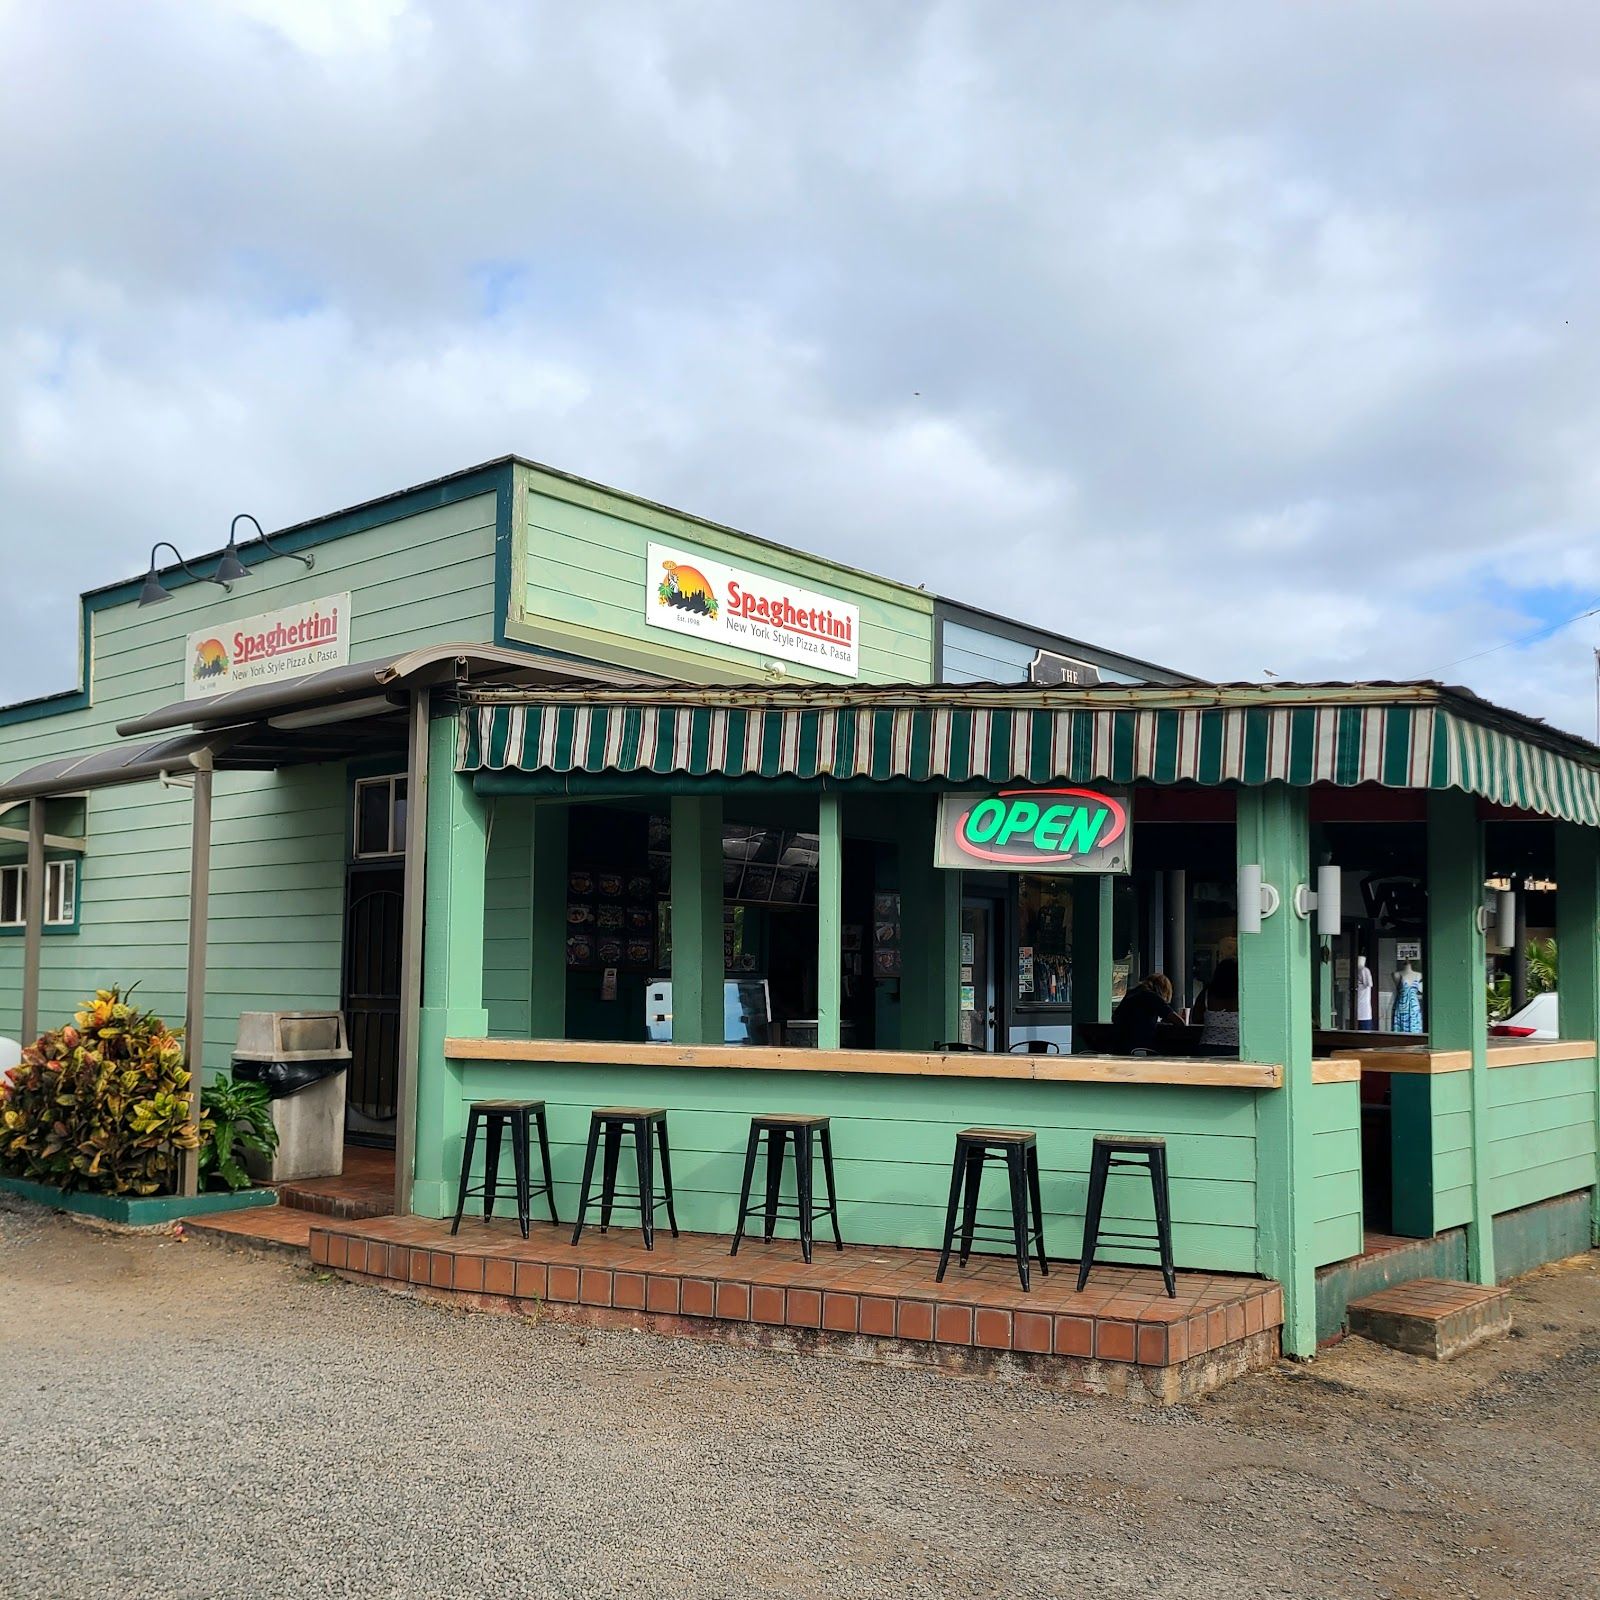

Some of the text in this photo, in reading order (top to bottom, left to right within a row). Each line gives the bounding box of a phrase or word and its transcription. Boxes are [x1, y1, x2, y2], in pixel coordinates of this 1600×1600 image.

[233, 607, 338, 662] Spaghettini
[727, 581, 851, 641] Spaghettini
[726, 617, 851, 661] New York Style Pizza & Pasta
[231, 650, 338, 681] New York Style Pizza & Pasta
[1061, 668, 1079, 684] THE
[965, 798, 1108, 854] OPEN
